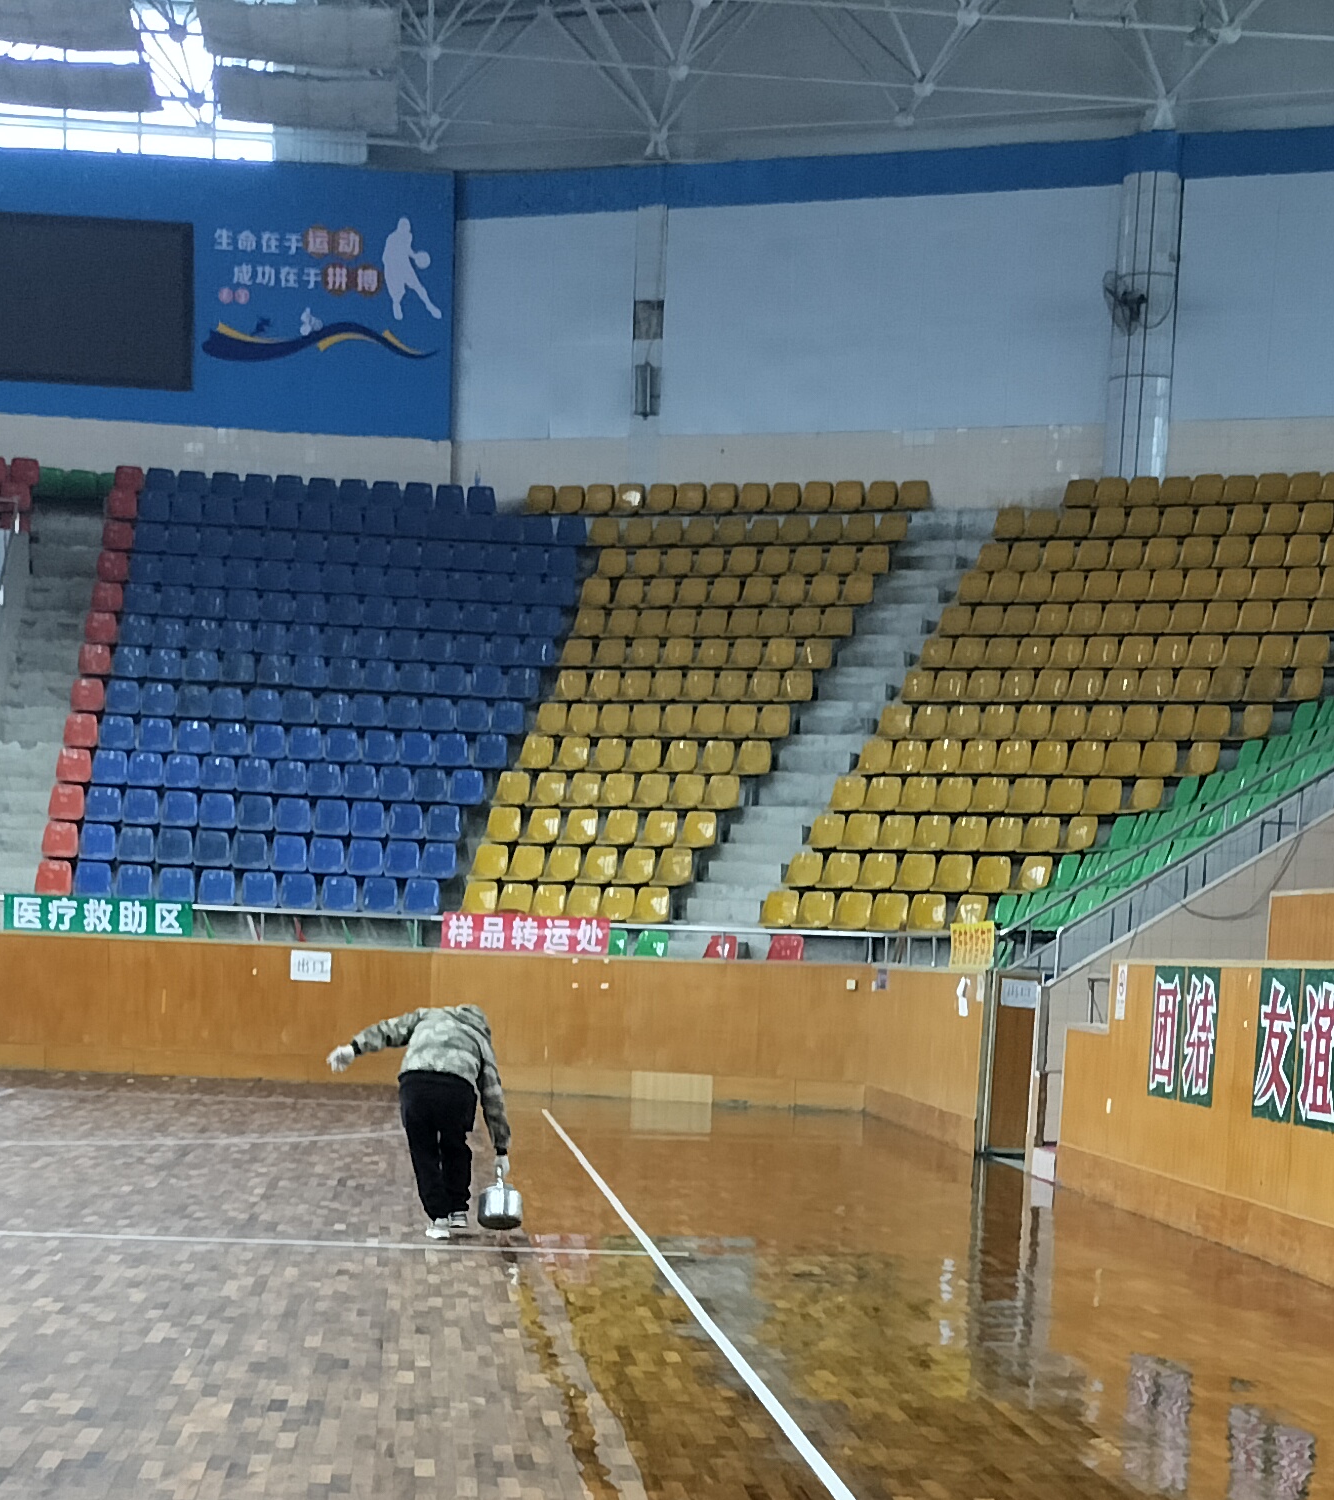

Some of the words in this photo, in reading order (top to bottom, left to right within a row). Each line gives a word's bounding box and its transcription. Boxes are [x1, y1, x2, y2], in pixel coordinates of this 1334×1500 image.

[213, 227, 361, 257] 生命在于运动
[233, 263, 379, 292] 成功在于拼搏
[13, 897, 183, 934] 医疗救助区
[447, 914, 603, 953] 样品转运处
[1149, 973, 1216, 1098] 团结
